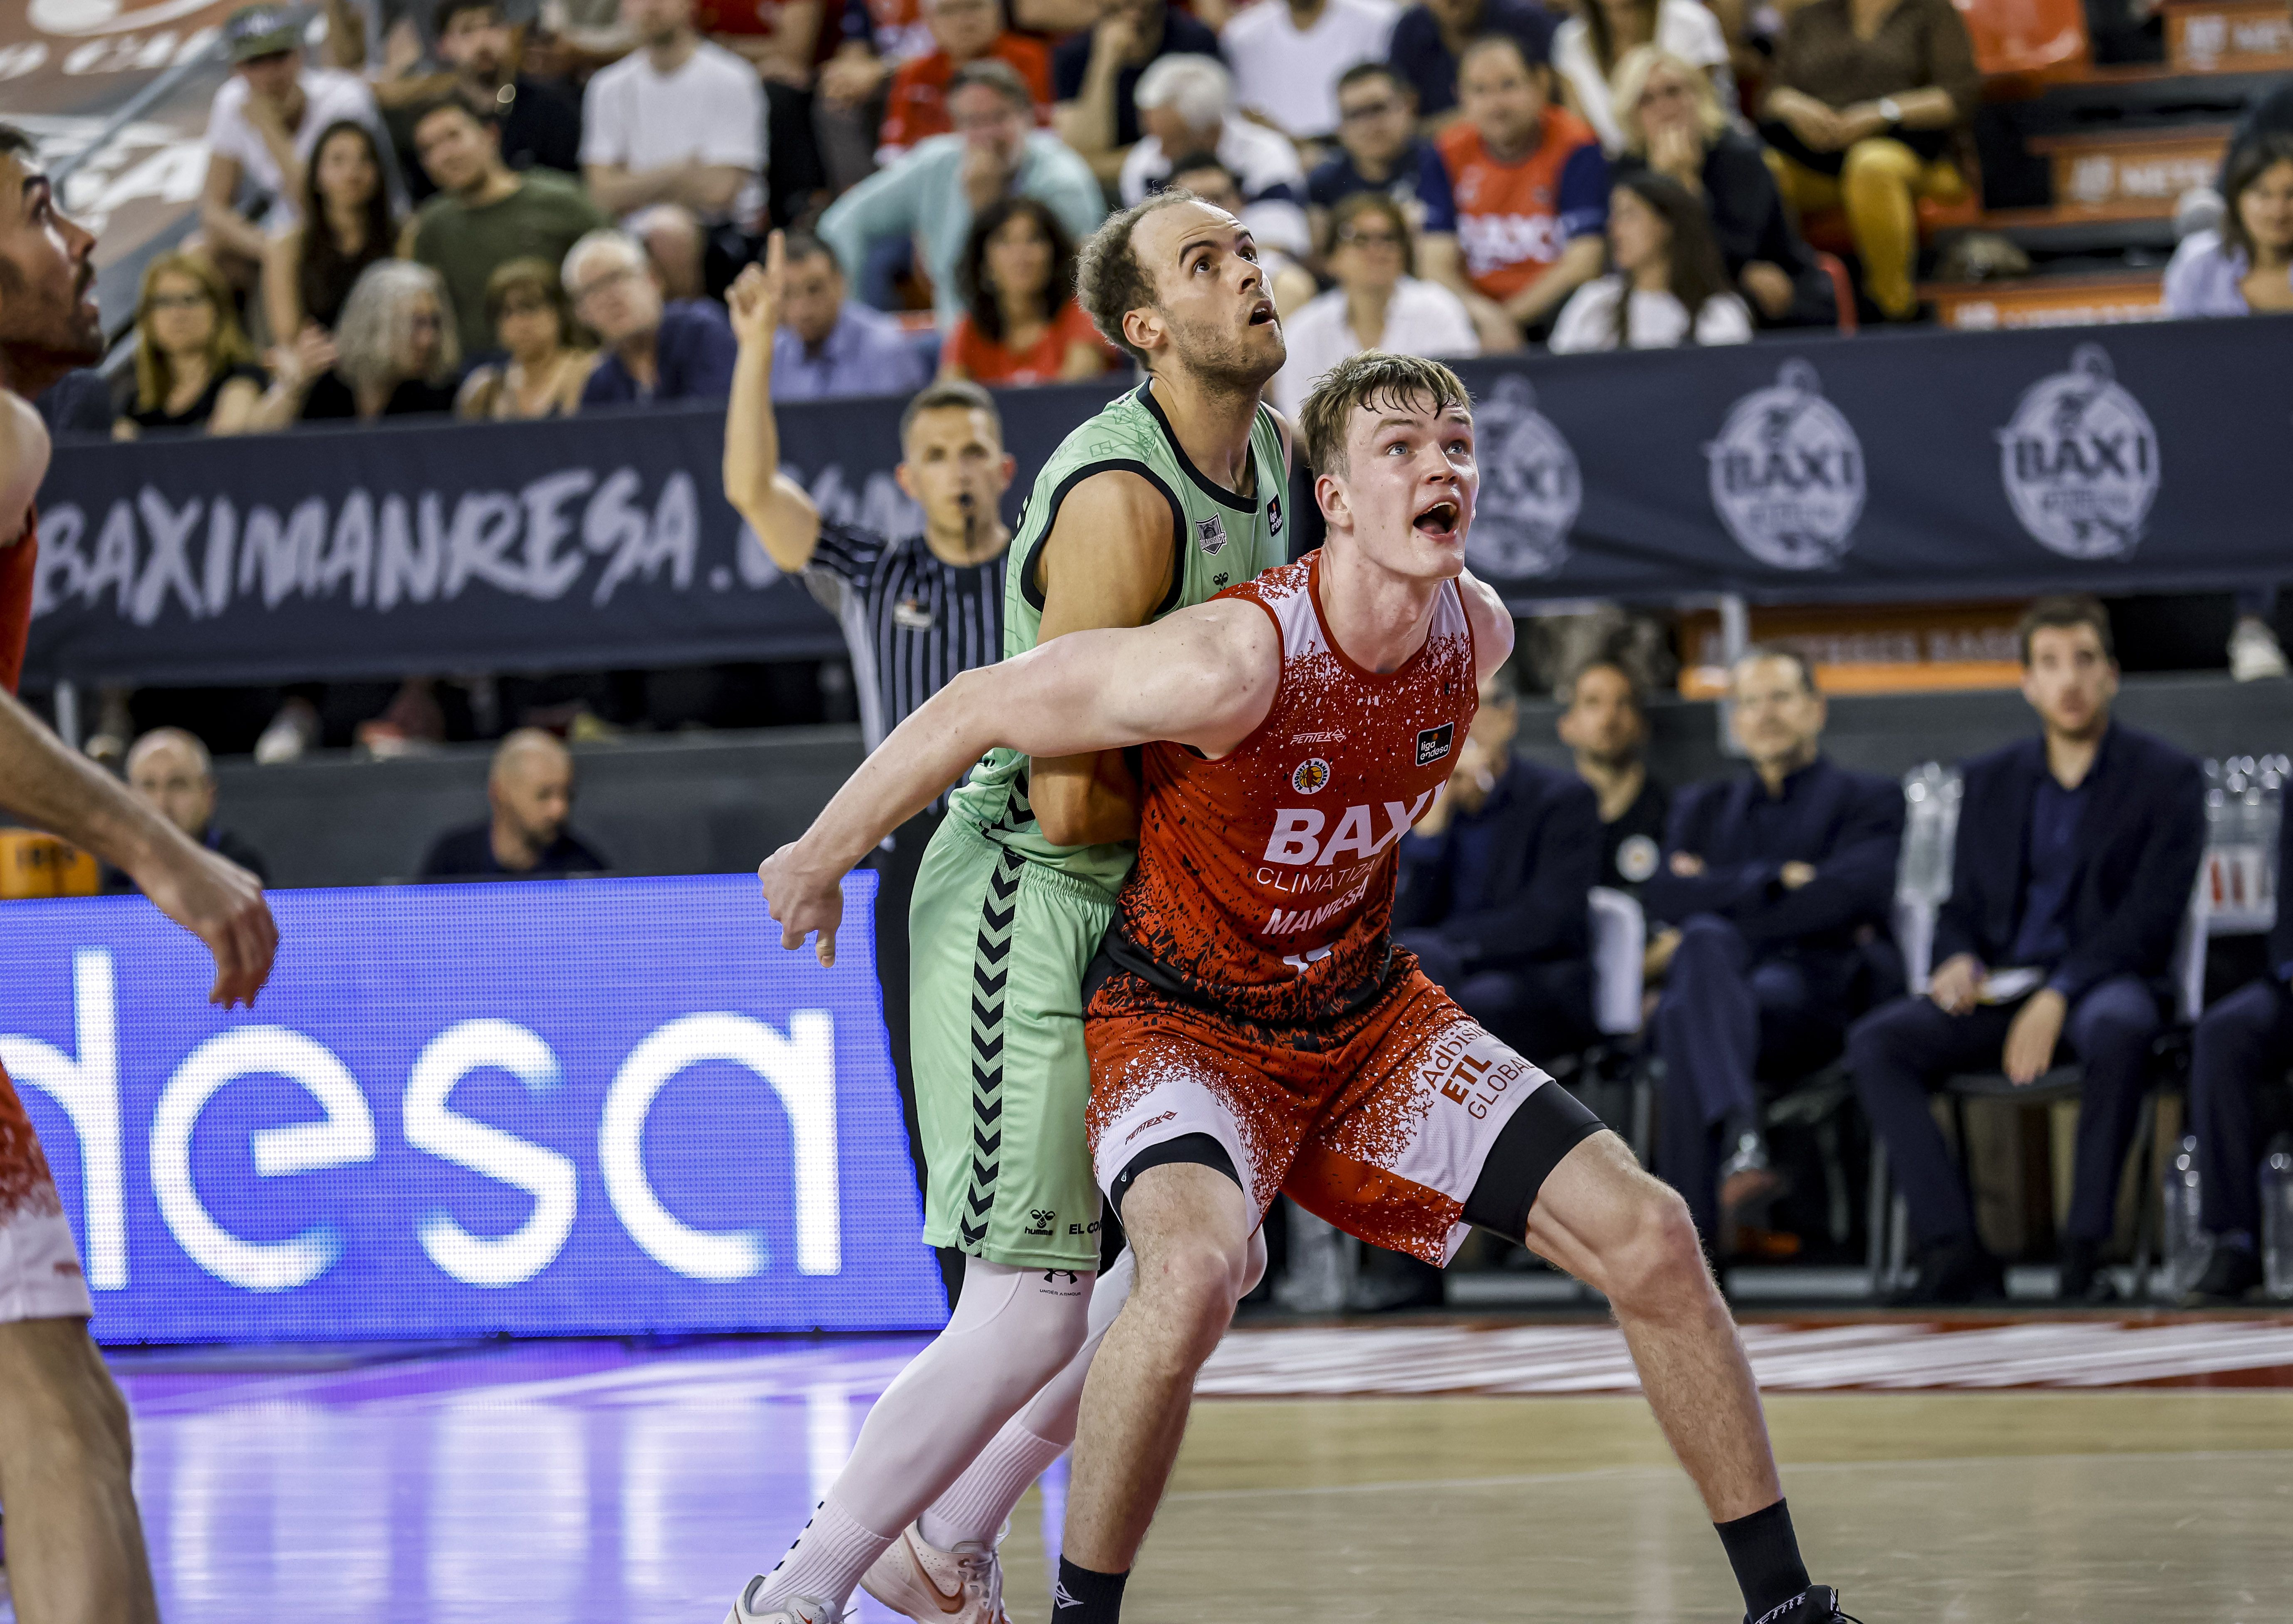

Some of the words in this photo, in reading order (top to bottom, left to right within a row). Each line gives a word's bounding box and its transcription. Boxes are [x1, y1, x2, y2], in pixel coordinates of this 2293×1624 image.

[1420, 744, 1449, 760] endesa
[1421, 741, 1436, 752] liga
[1256, 854, 1386, 894] CLIMATIZA
[1261, 874, 1369, 934] MANRESA
[1440, 1054, 1493, 1106] ETL
[1468, 1056, 1535, 1120] GLOBAL
[1069, 1223, 1085, 1235] EL
